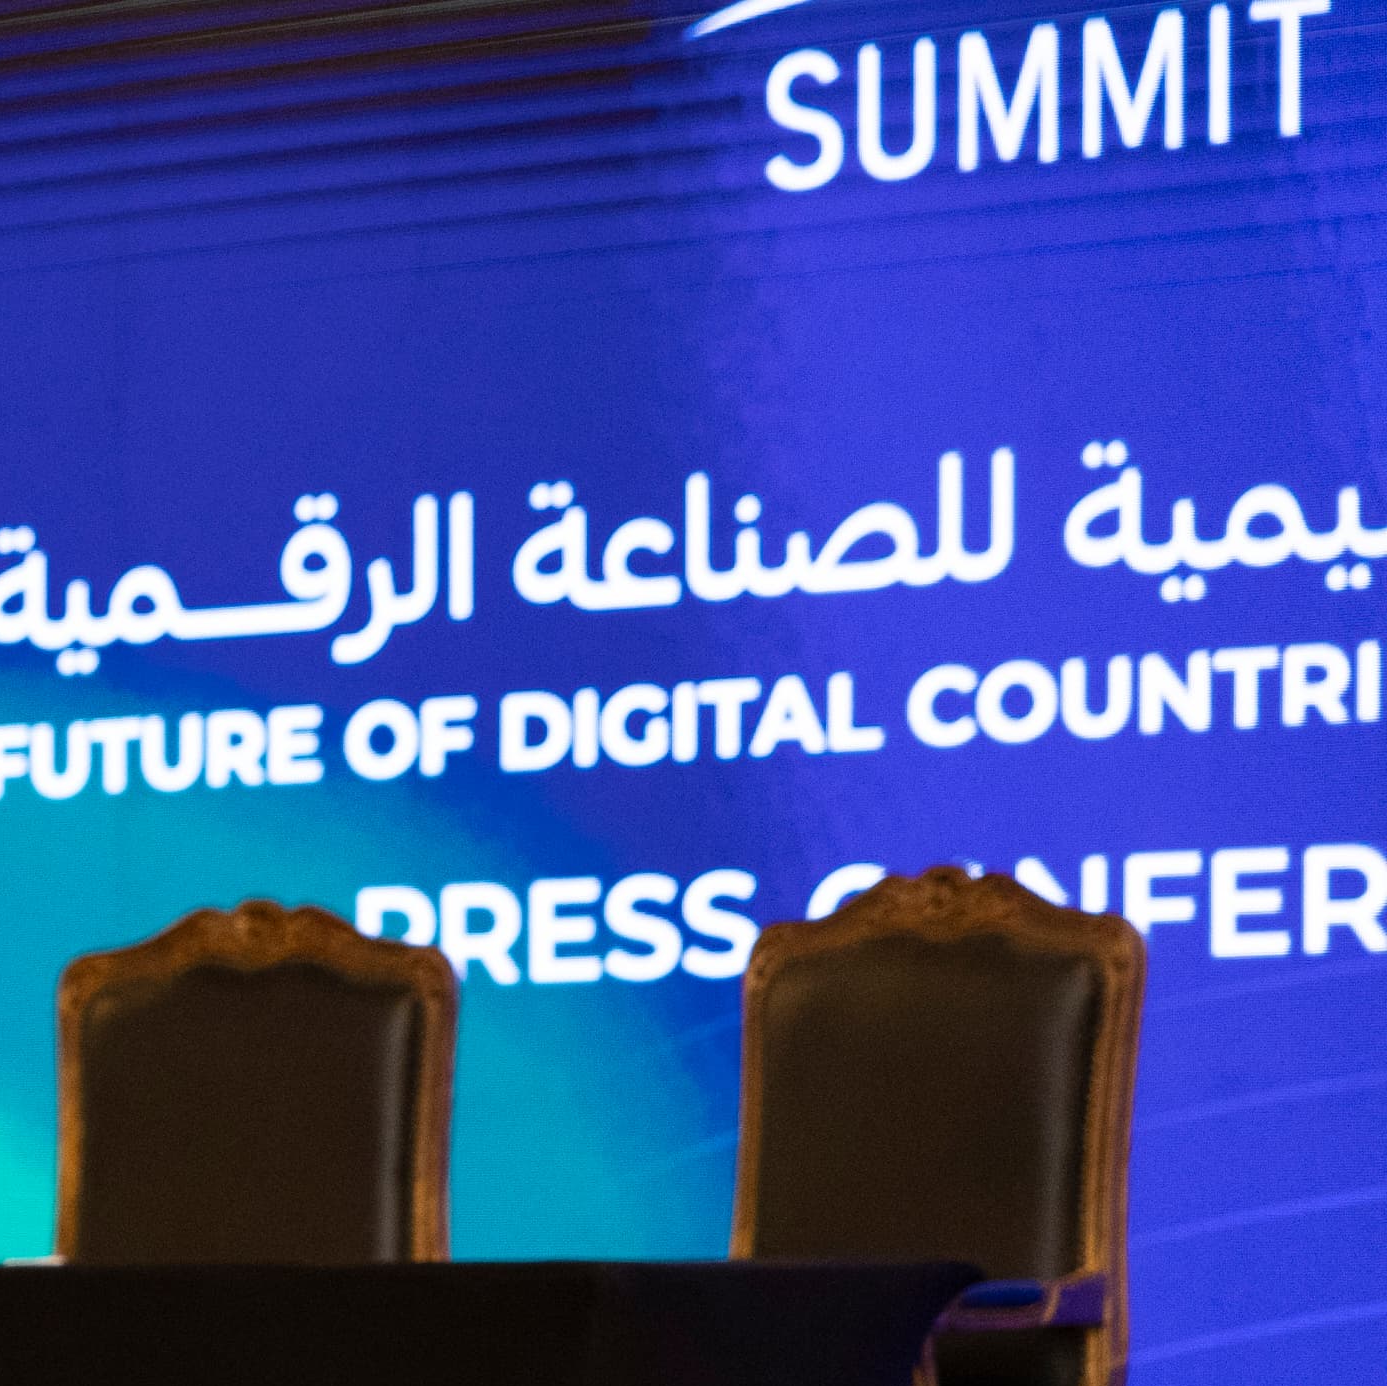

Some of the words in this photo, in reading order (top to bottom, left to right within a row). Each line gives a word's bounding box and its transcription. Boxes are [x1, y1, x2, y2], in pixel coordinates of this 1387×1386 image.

[764, 0, 1331, 192] SUMMIT
[512, 447, 1015, 611] للصناعة
[344, 696, 477, 780] OF
[500, 672, 885, 771] DIGITAL
[355, 870, 759, 984] PRESS
